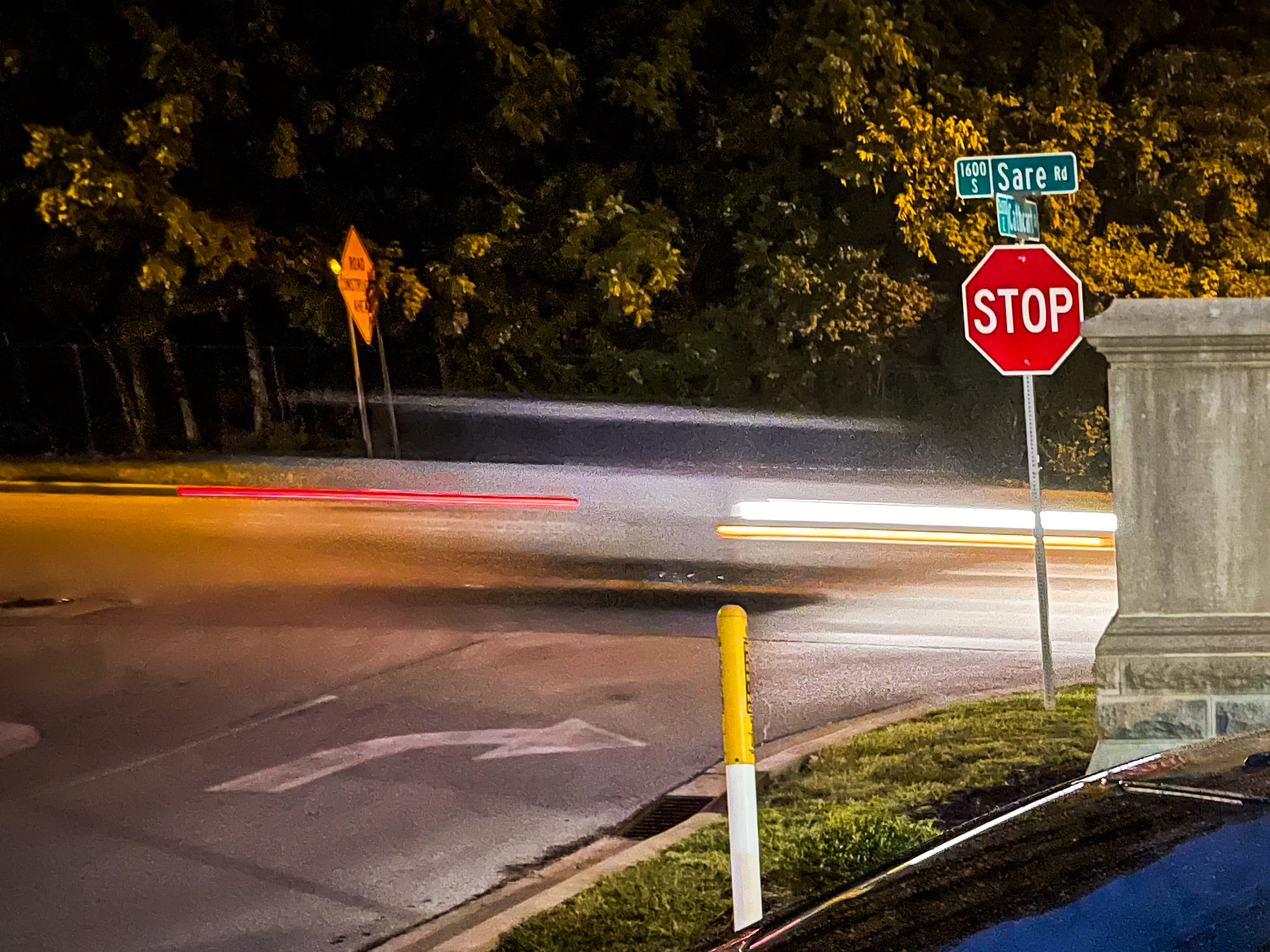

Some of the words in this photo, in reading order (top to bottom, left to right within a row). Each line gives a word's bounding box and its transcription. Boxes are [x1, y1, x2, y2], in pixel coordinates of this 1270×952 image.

[960, 161, 987, 177] 1600
[997, 162, 1047, 191] Sare
[1053, 165, 1068, 181] Rd
[971, 178, 979, 193] S
[974, 287, 1073, 334] STOP
